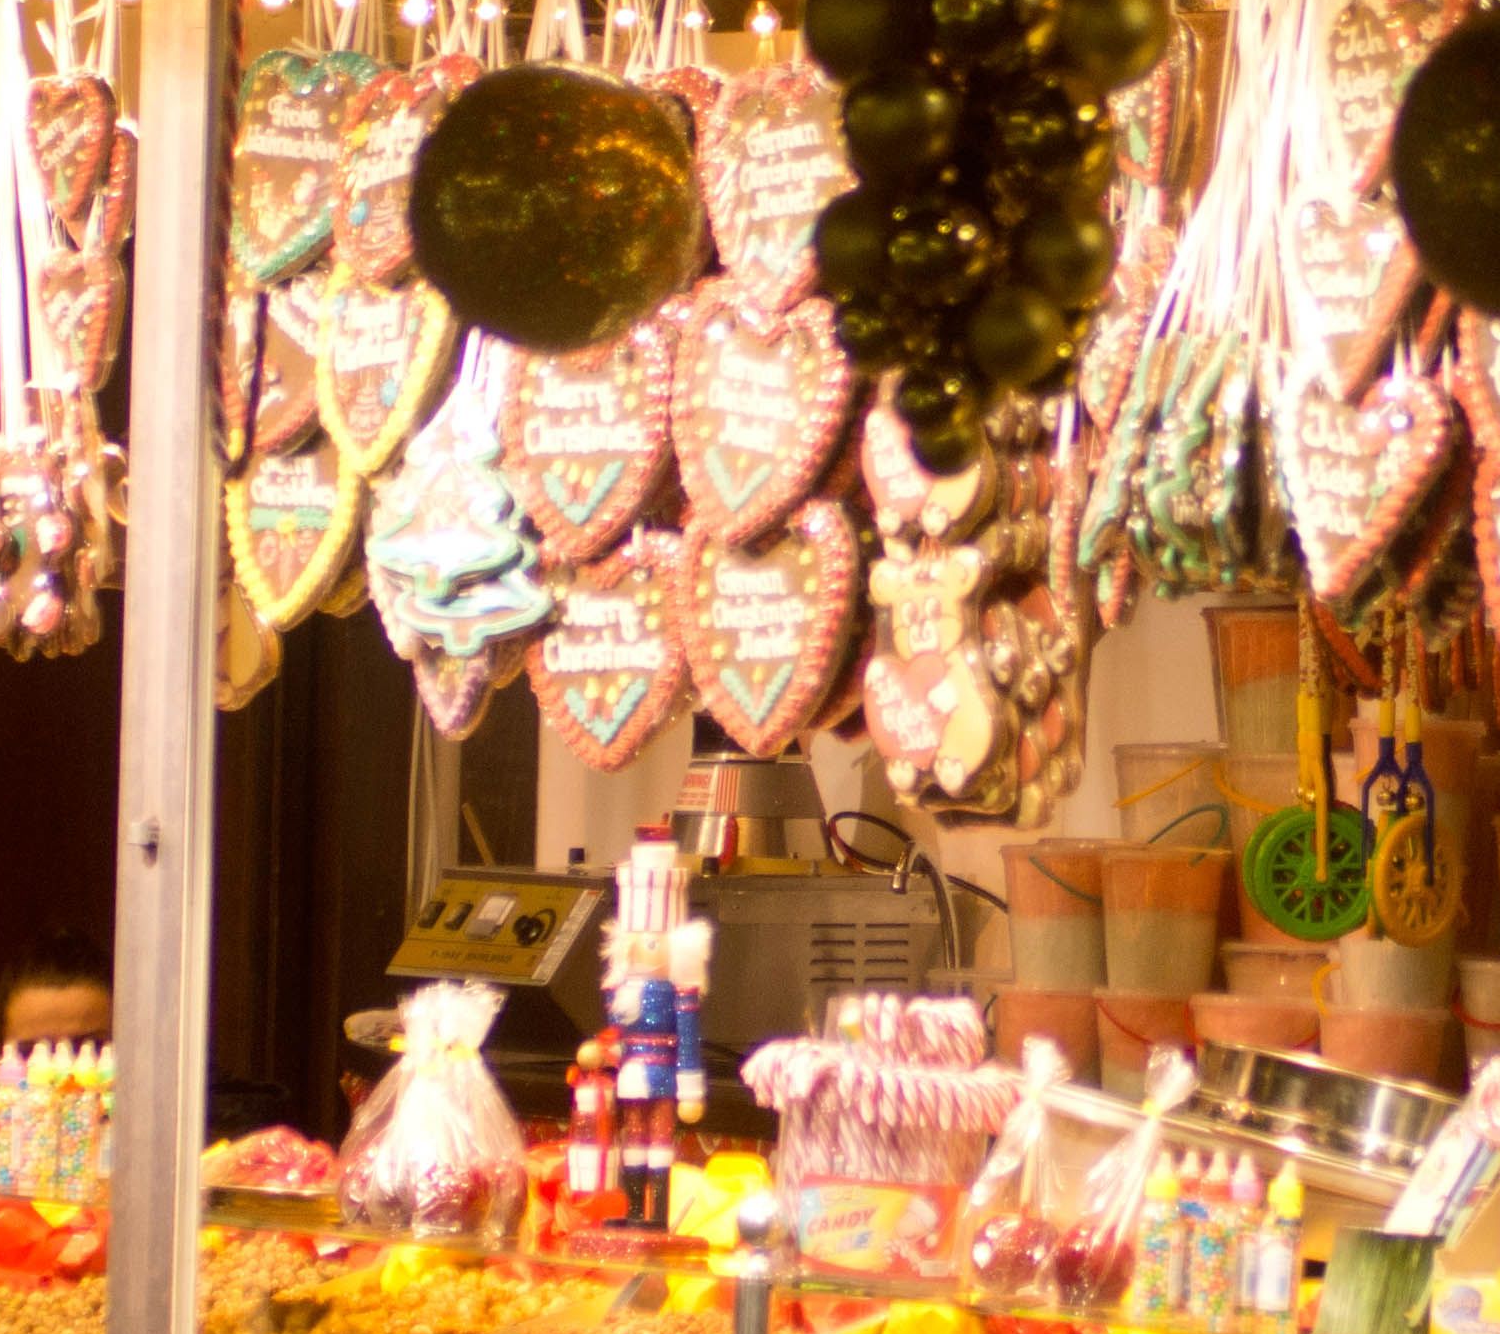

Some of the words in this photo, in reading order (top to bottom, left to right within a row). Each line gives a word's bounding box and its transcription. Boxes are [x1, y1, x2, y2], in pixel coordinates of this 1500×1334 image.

[534, 377, 617, 423] Merry
[525, 416, 648, 455] Christmas
[715, 564, 788, 596] German
[562, 593, 641, 643] Merry
[712, 596, 806, 630] Christmas
[544, 630, 665, 673] Christmas
[806, 1205, 880, 1236] CANDY
